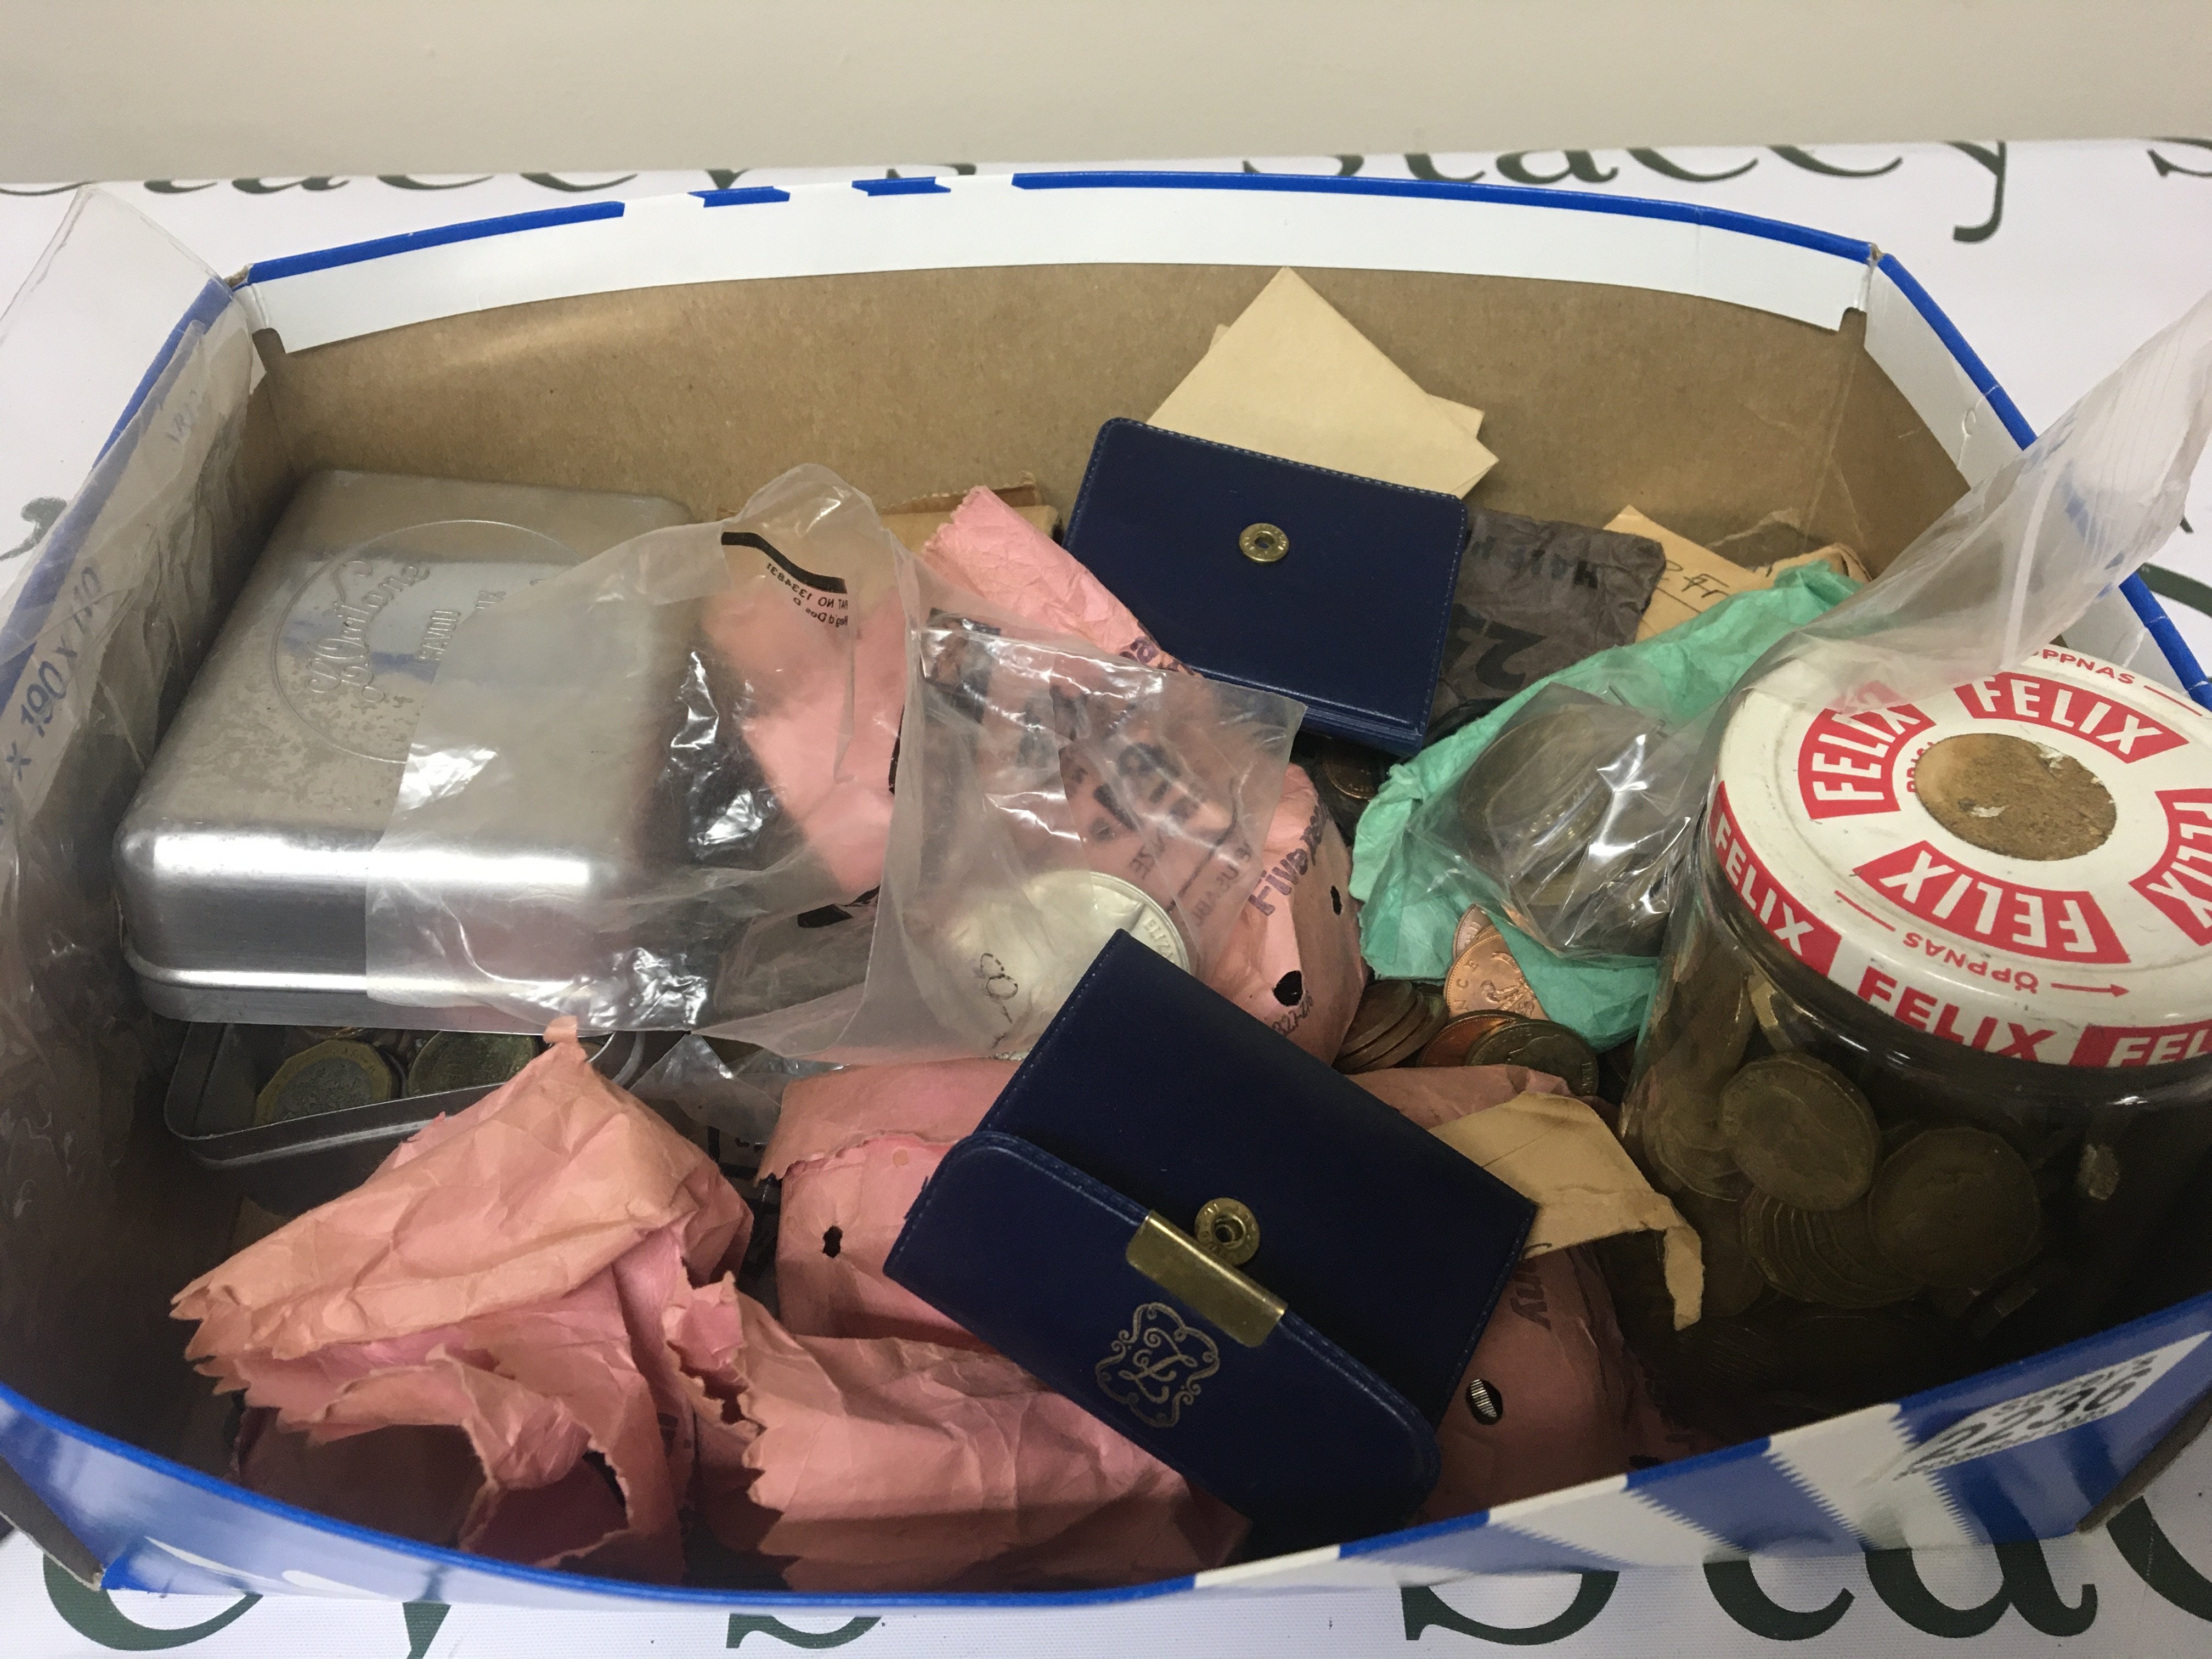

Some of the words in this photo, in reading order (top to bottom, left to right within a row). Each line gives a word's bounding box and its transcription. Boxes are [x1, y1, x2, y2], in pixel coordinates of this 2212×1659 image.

[1812, 690, 1921, 800] FELIX
[1973, 675, 2164, 757] FELIX
[1714, 811, 1815, 955] FELIX
[1880, 850, 2098, 953] FELIX
[1857, 967, 2059, 1062] FELIX
[1910, 1367, 2154, 1468] 2236
